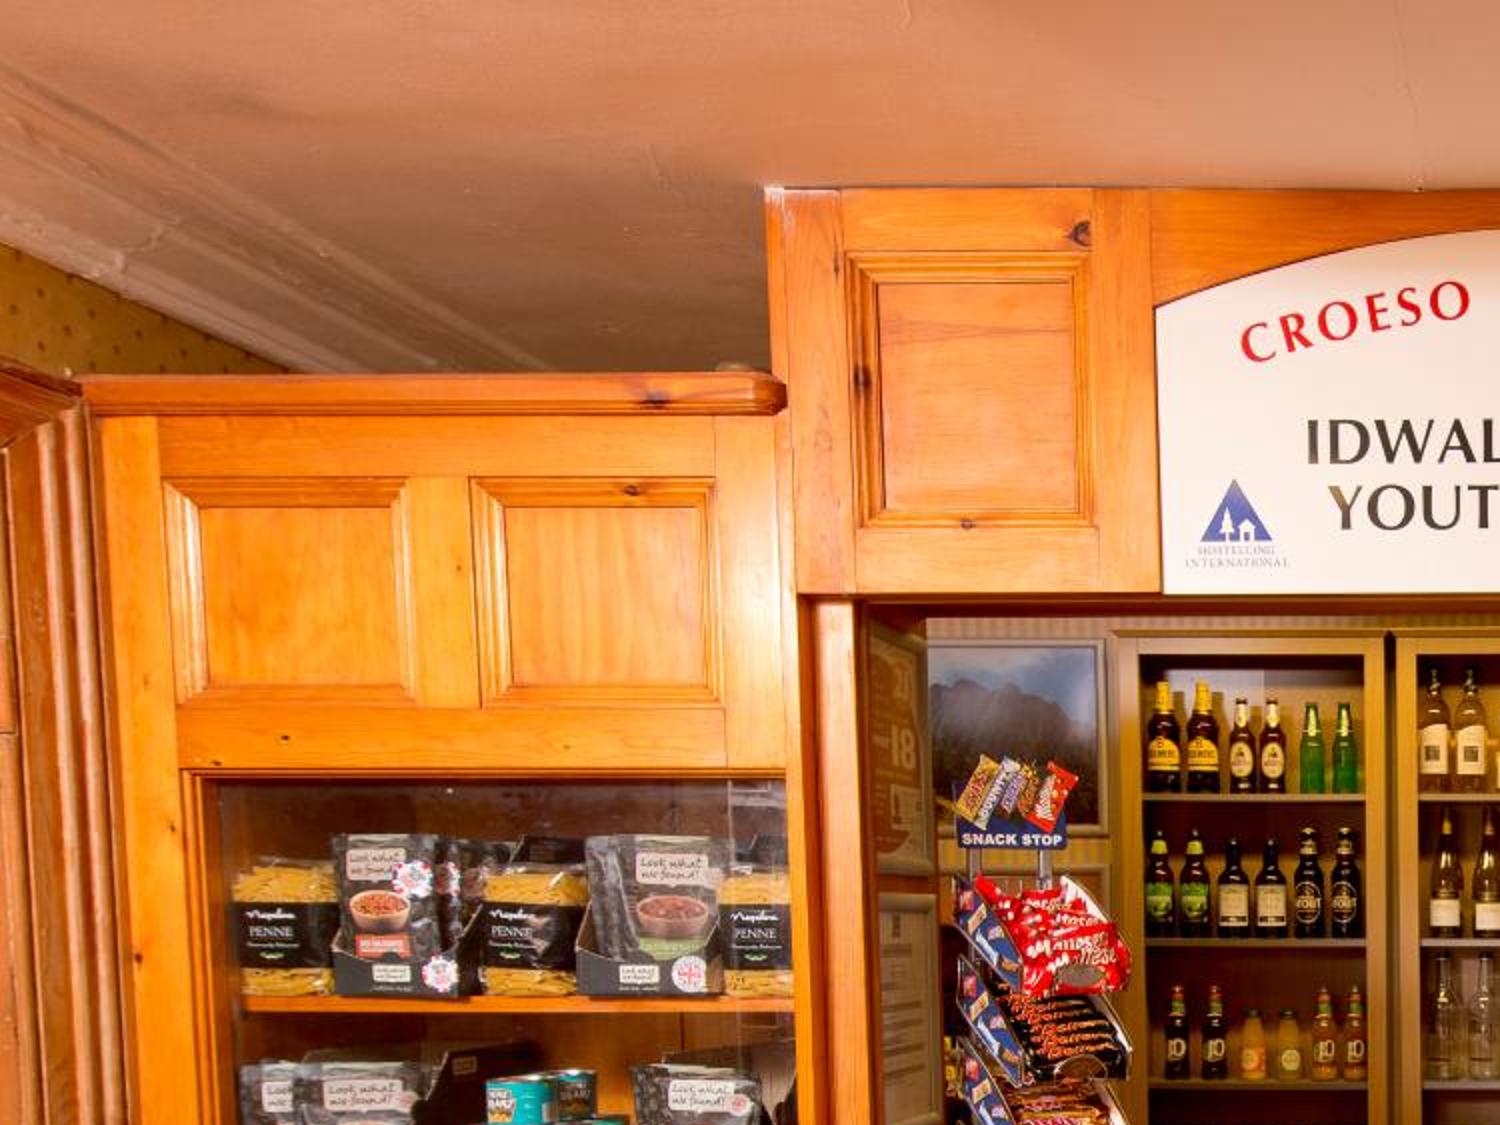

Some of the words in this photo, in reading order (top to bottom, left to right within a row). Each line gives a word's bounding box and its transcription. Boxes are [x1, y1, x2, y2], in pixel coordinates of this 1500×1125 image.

[1241, 280, 1471, 363] CROESO
[961, 833, 1017, 846] SNACK
[1021, 833, 1063, 847] STOP
[249, 926, 294, 938] PENNE
[491, 926, 533, 938] PENNE
[735, 927, 777, 939] PENNE
